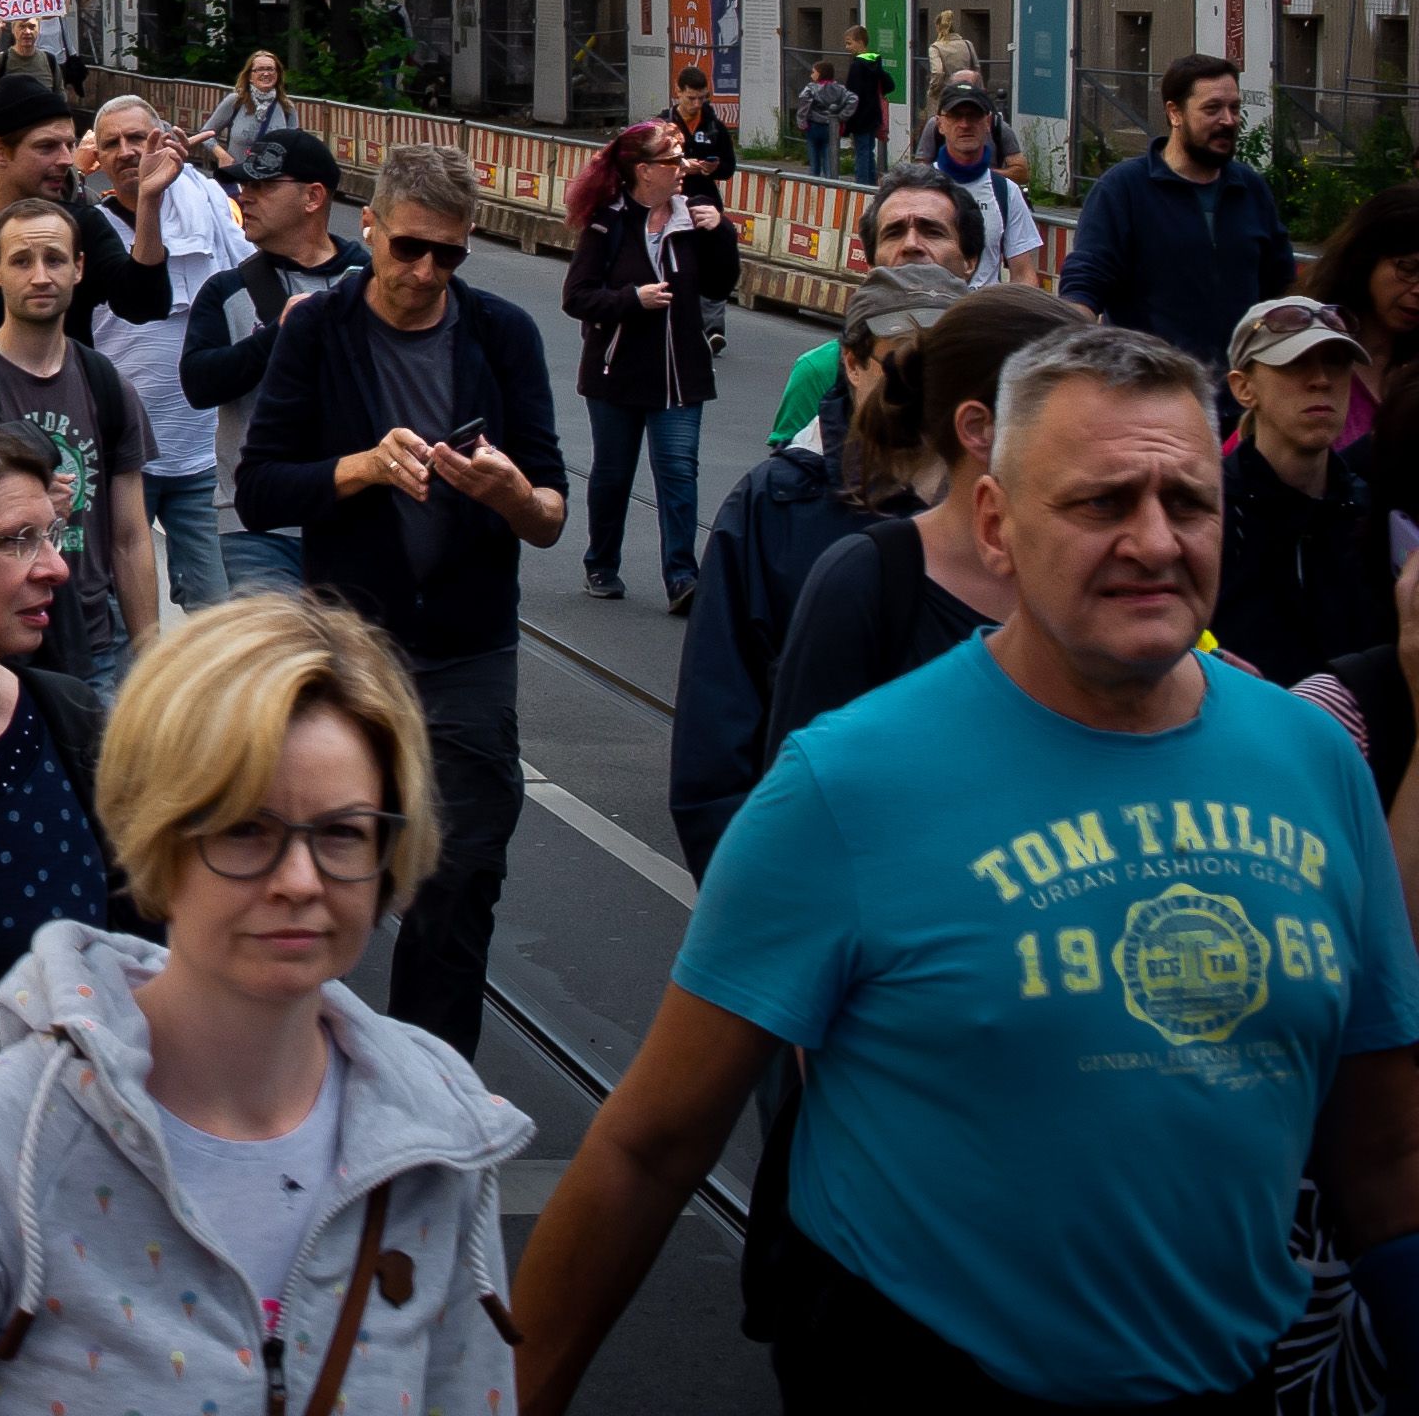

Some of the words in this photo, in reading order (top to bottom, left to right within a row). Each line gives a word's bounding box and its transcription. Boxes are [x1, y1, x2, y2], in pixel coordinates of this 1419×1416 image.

[970, 811, 1116, 903] TOM
[1120, 800, 1327, 886] TAILOR
[1028, 865, 1117, 911] URBAN
[1124, 855, 1242, 882] FASHION
[1018, 927, 1102, 997] 19
